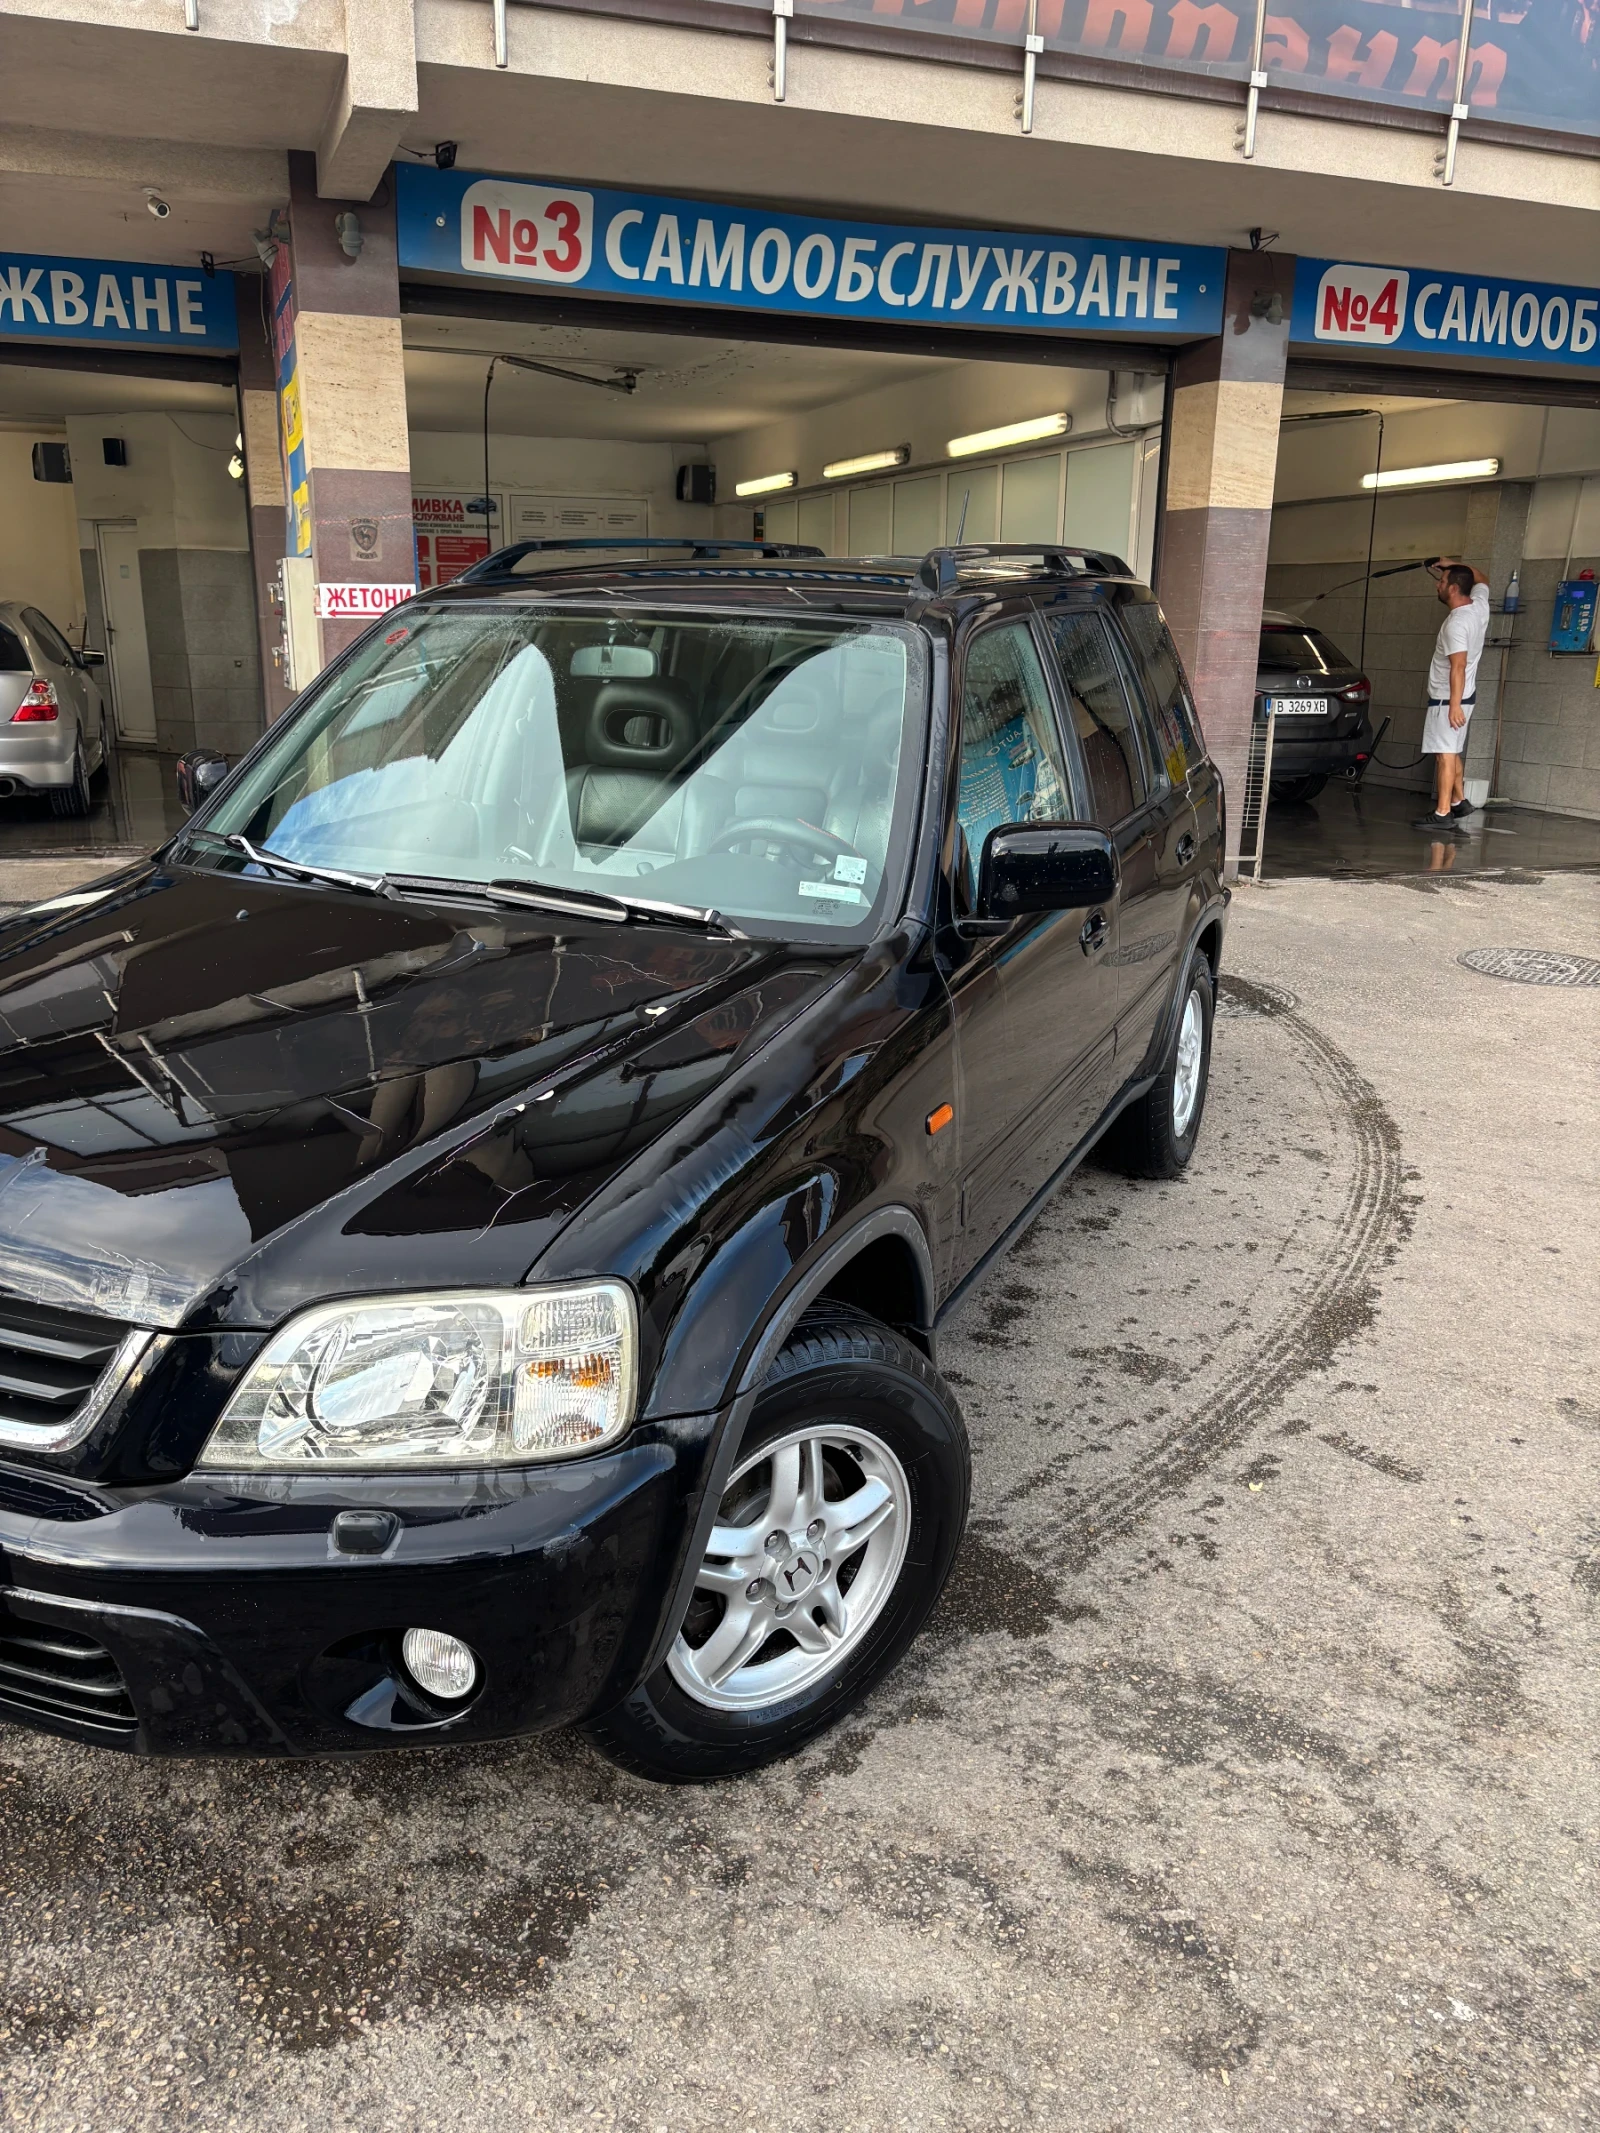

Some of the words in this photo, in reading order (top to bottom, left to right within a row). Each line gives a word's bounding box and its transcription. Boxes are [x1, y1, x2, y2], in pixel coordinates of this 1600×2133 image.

[605, 209, 1181, 320] САМООБСЛУЖВАНЕ
[0, 266, 207, 335] ЖВАНЕ
[1413, 282, 1599, 353] САМООБ
[326, 587, 412, 608] ЖЕТОНИ
[1288, 701, 1312, 713] 3269
